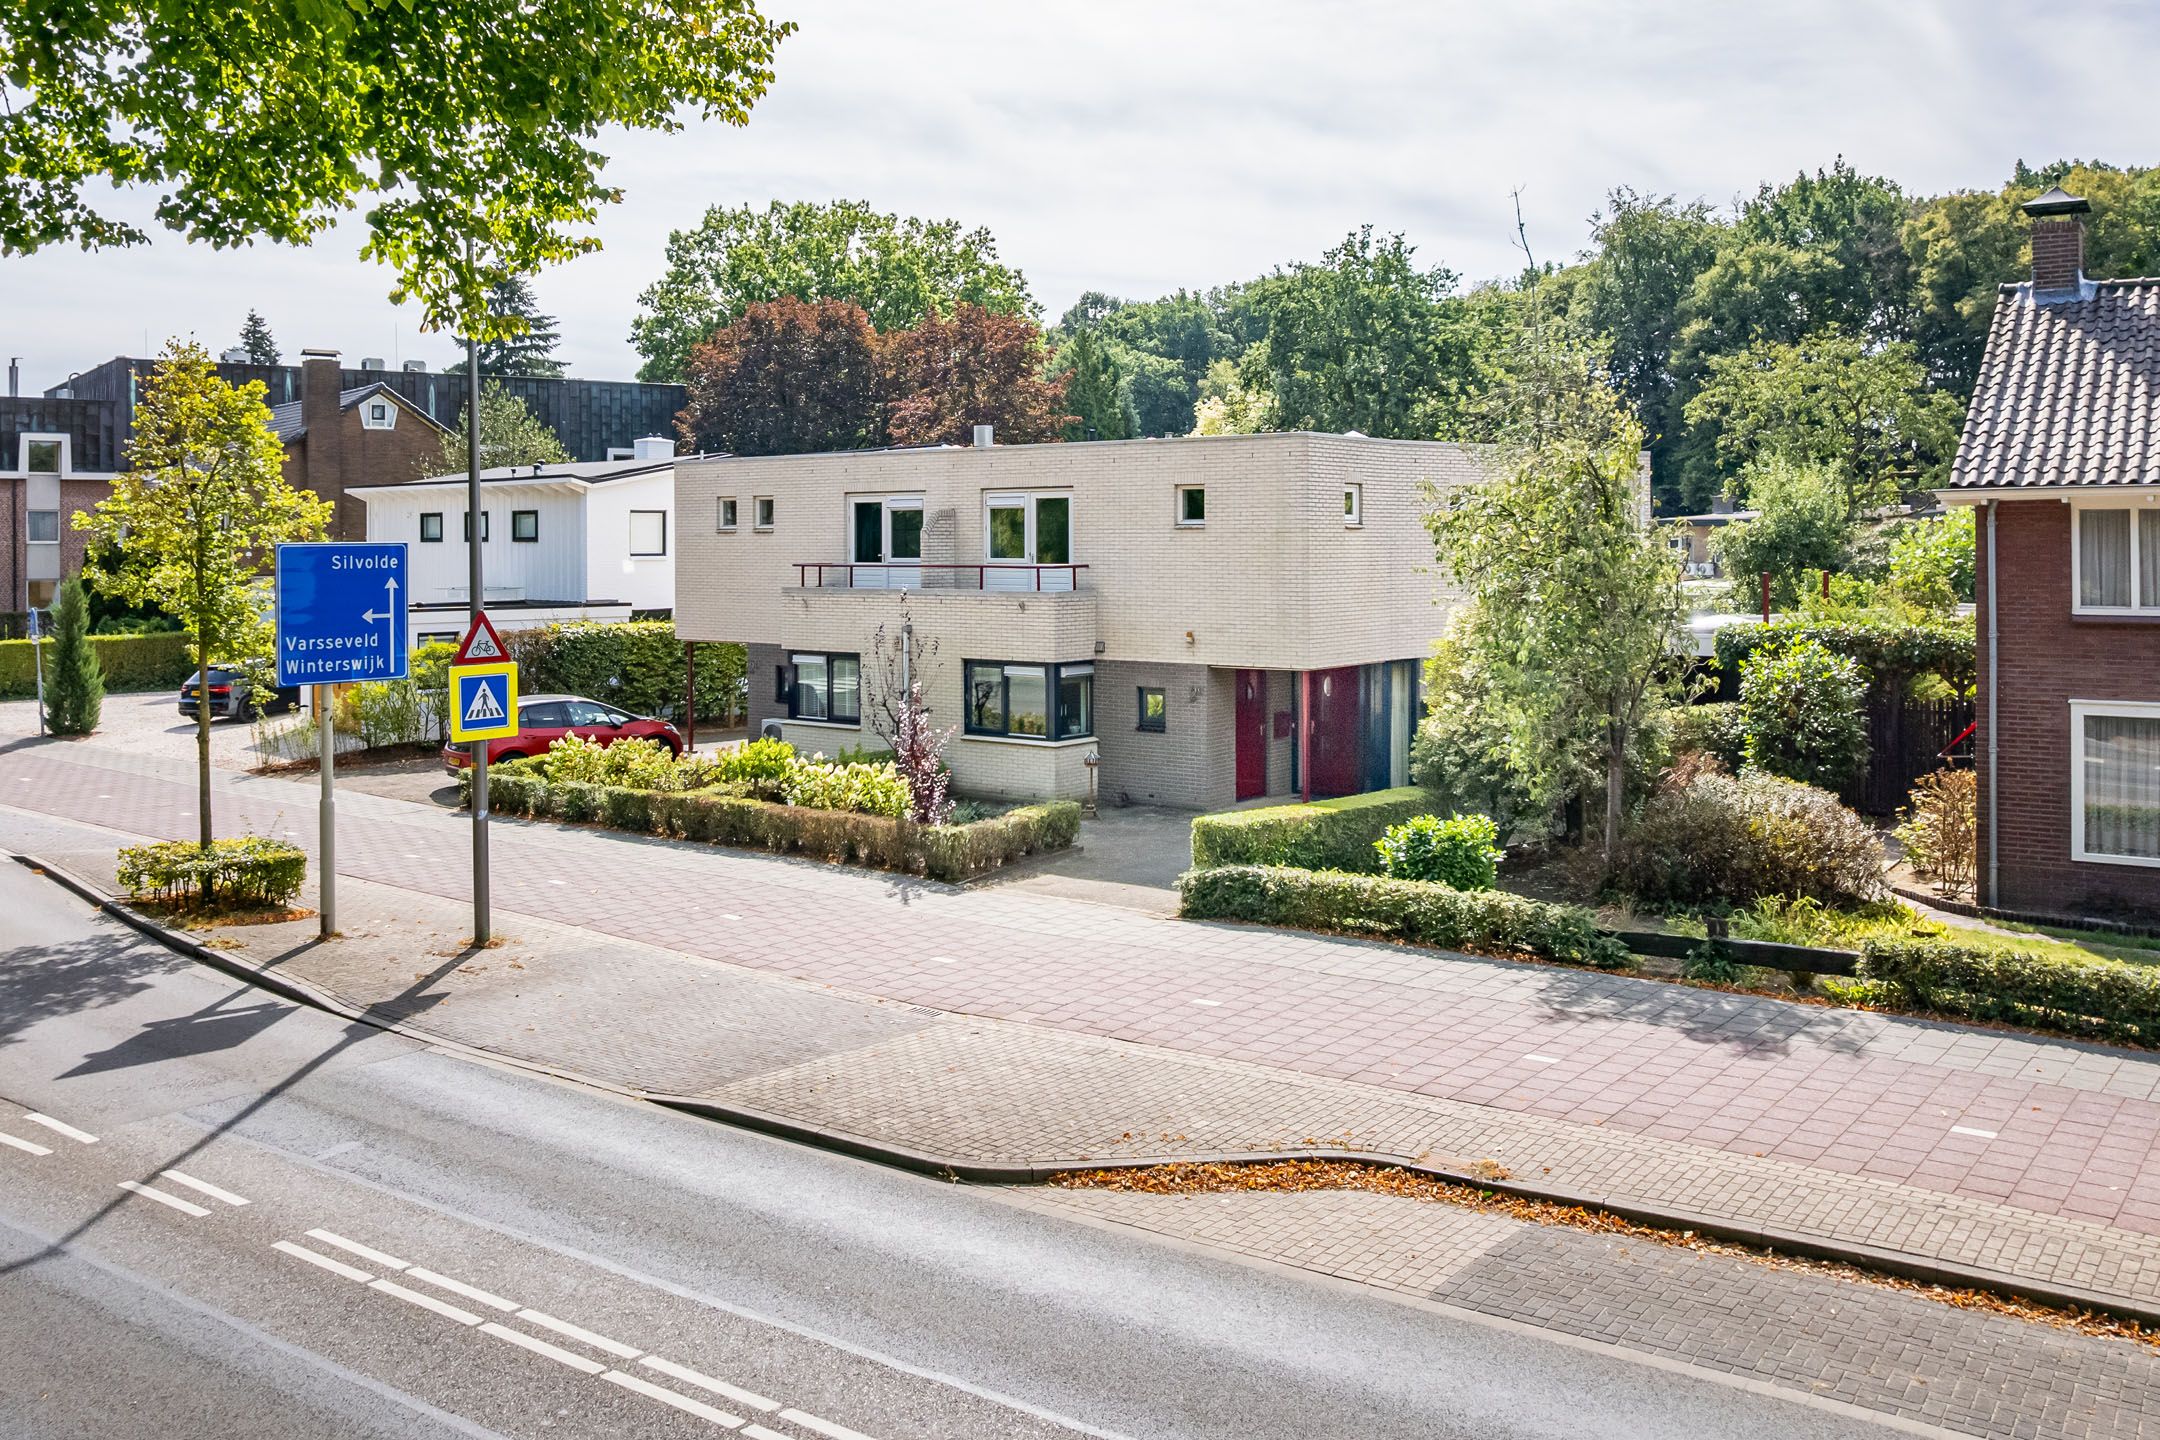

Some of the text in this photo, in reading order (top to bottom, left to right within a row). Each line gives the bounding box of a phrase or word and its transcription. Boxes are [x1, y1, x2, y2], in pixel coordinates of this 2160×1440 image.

[331, 555, 399, 570] Silvolde
[286, 632, 379, 651] Varsseveld
[286, 655, 385, 675] Winterswijk
